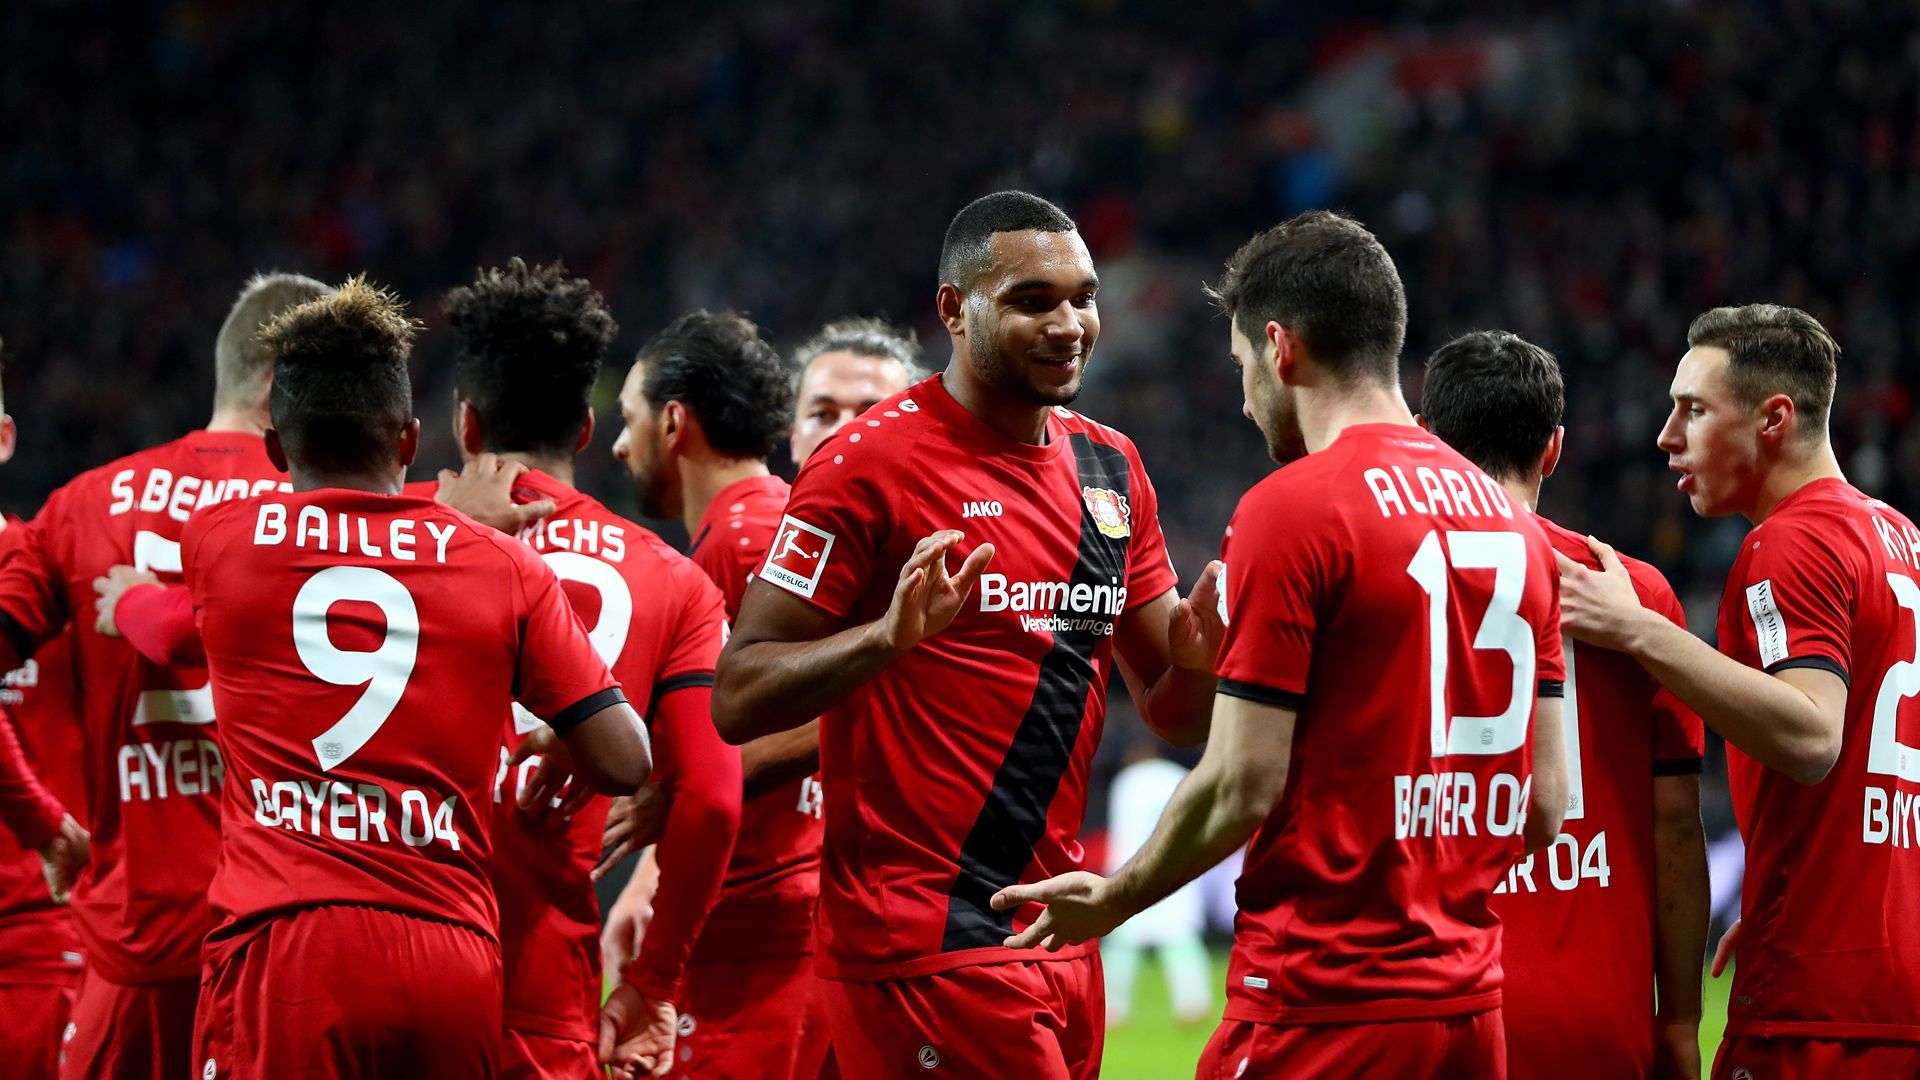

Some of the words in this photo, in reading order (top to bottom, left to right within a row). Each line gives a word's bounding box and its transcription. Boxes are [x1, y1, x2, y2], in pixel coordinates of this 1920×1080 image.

[109, 467, 294, 522] S.BEN
[962, 500, 1003, 518] JAKO
[1363, 465, 1514, 520] ALARIO
[253, 503, 457, 563] BAILEY
[765, 566, 809, 591] BUNDESLIGA
[980, 573, 1128, 616] Barmenia
[1020, 614, 1114, 636] Versicherunge
[1406, 529, 1537, 759] 13
[1758, 582, 1781, 661] WESTMINSTER
[292, 566, 420, 772] 9
[250, 778, 389, 843] BAYER
[401, 789, 460, 851] 04
[1394, 772, 1478, 840] BAYER
[1547, 830, 1611, 891] 04
